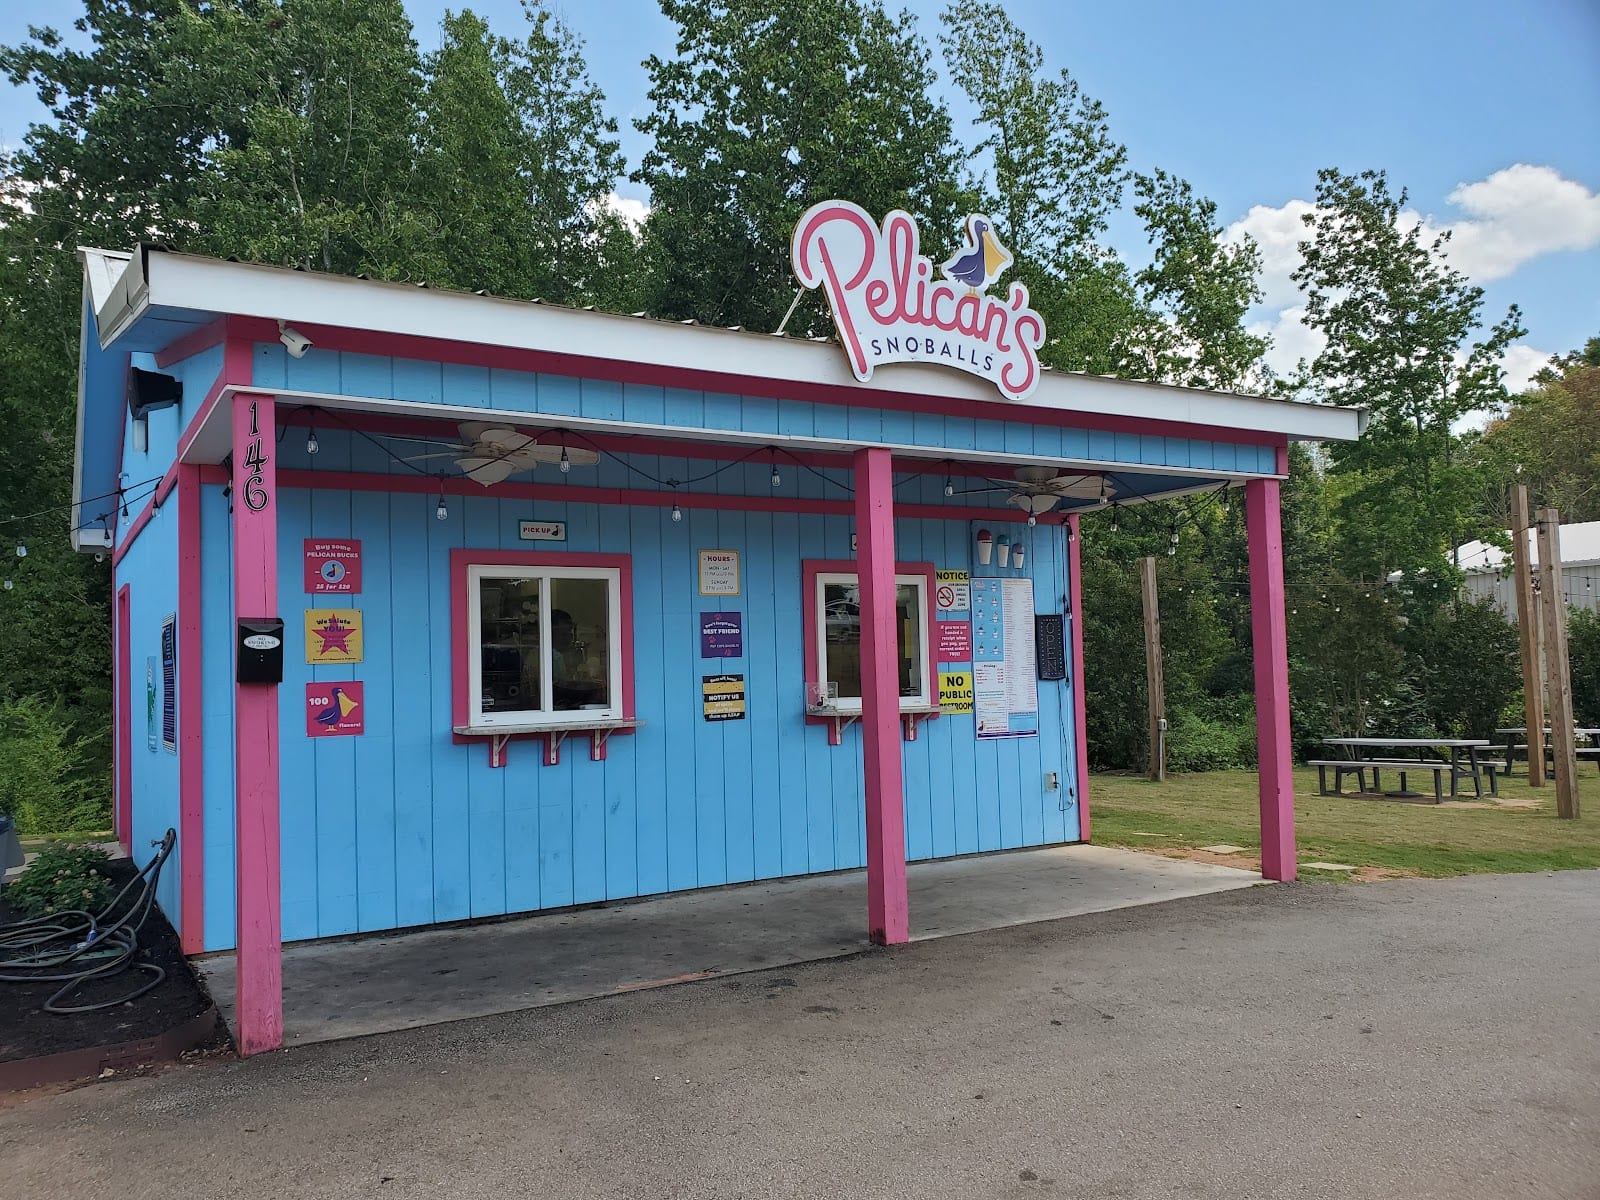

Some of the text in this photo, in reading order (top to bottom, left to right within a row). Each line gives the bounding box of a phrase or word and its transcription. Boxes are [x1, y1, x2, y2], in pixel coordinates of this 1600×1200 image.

[800, 207, 1040, 394] Pelican's
[871, 337, 993, 372] SNOBALLS
[243, 399, 269, 511] 146
[331, 544, 351, 552] some
[936, 571, 969, 580] NOTICE
[946, 676, 964, 687] NO
[939, 690, 972, 700] PUBLIC
[309, 697, 329, 706] 100
